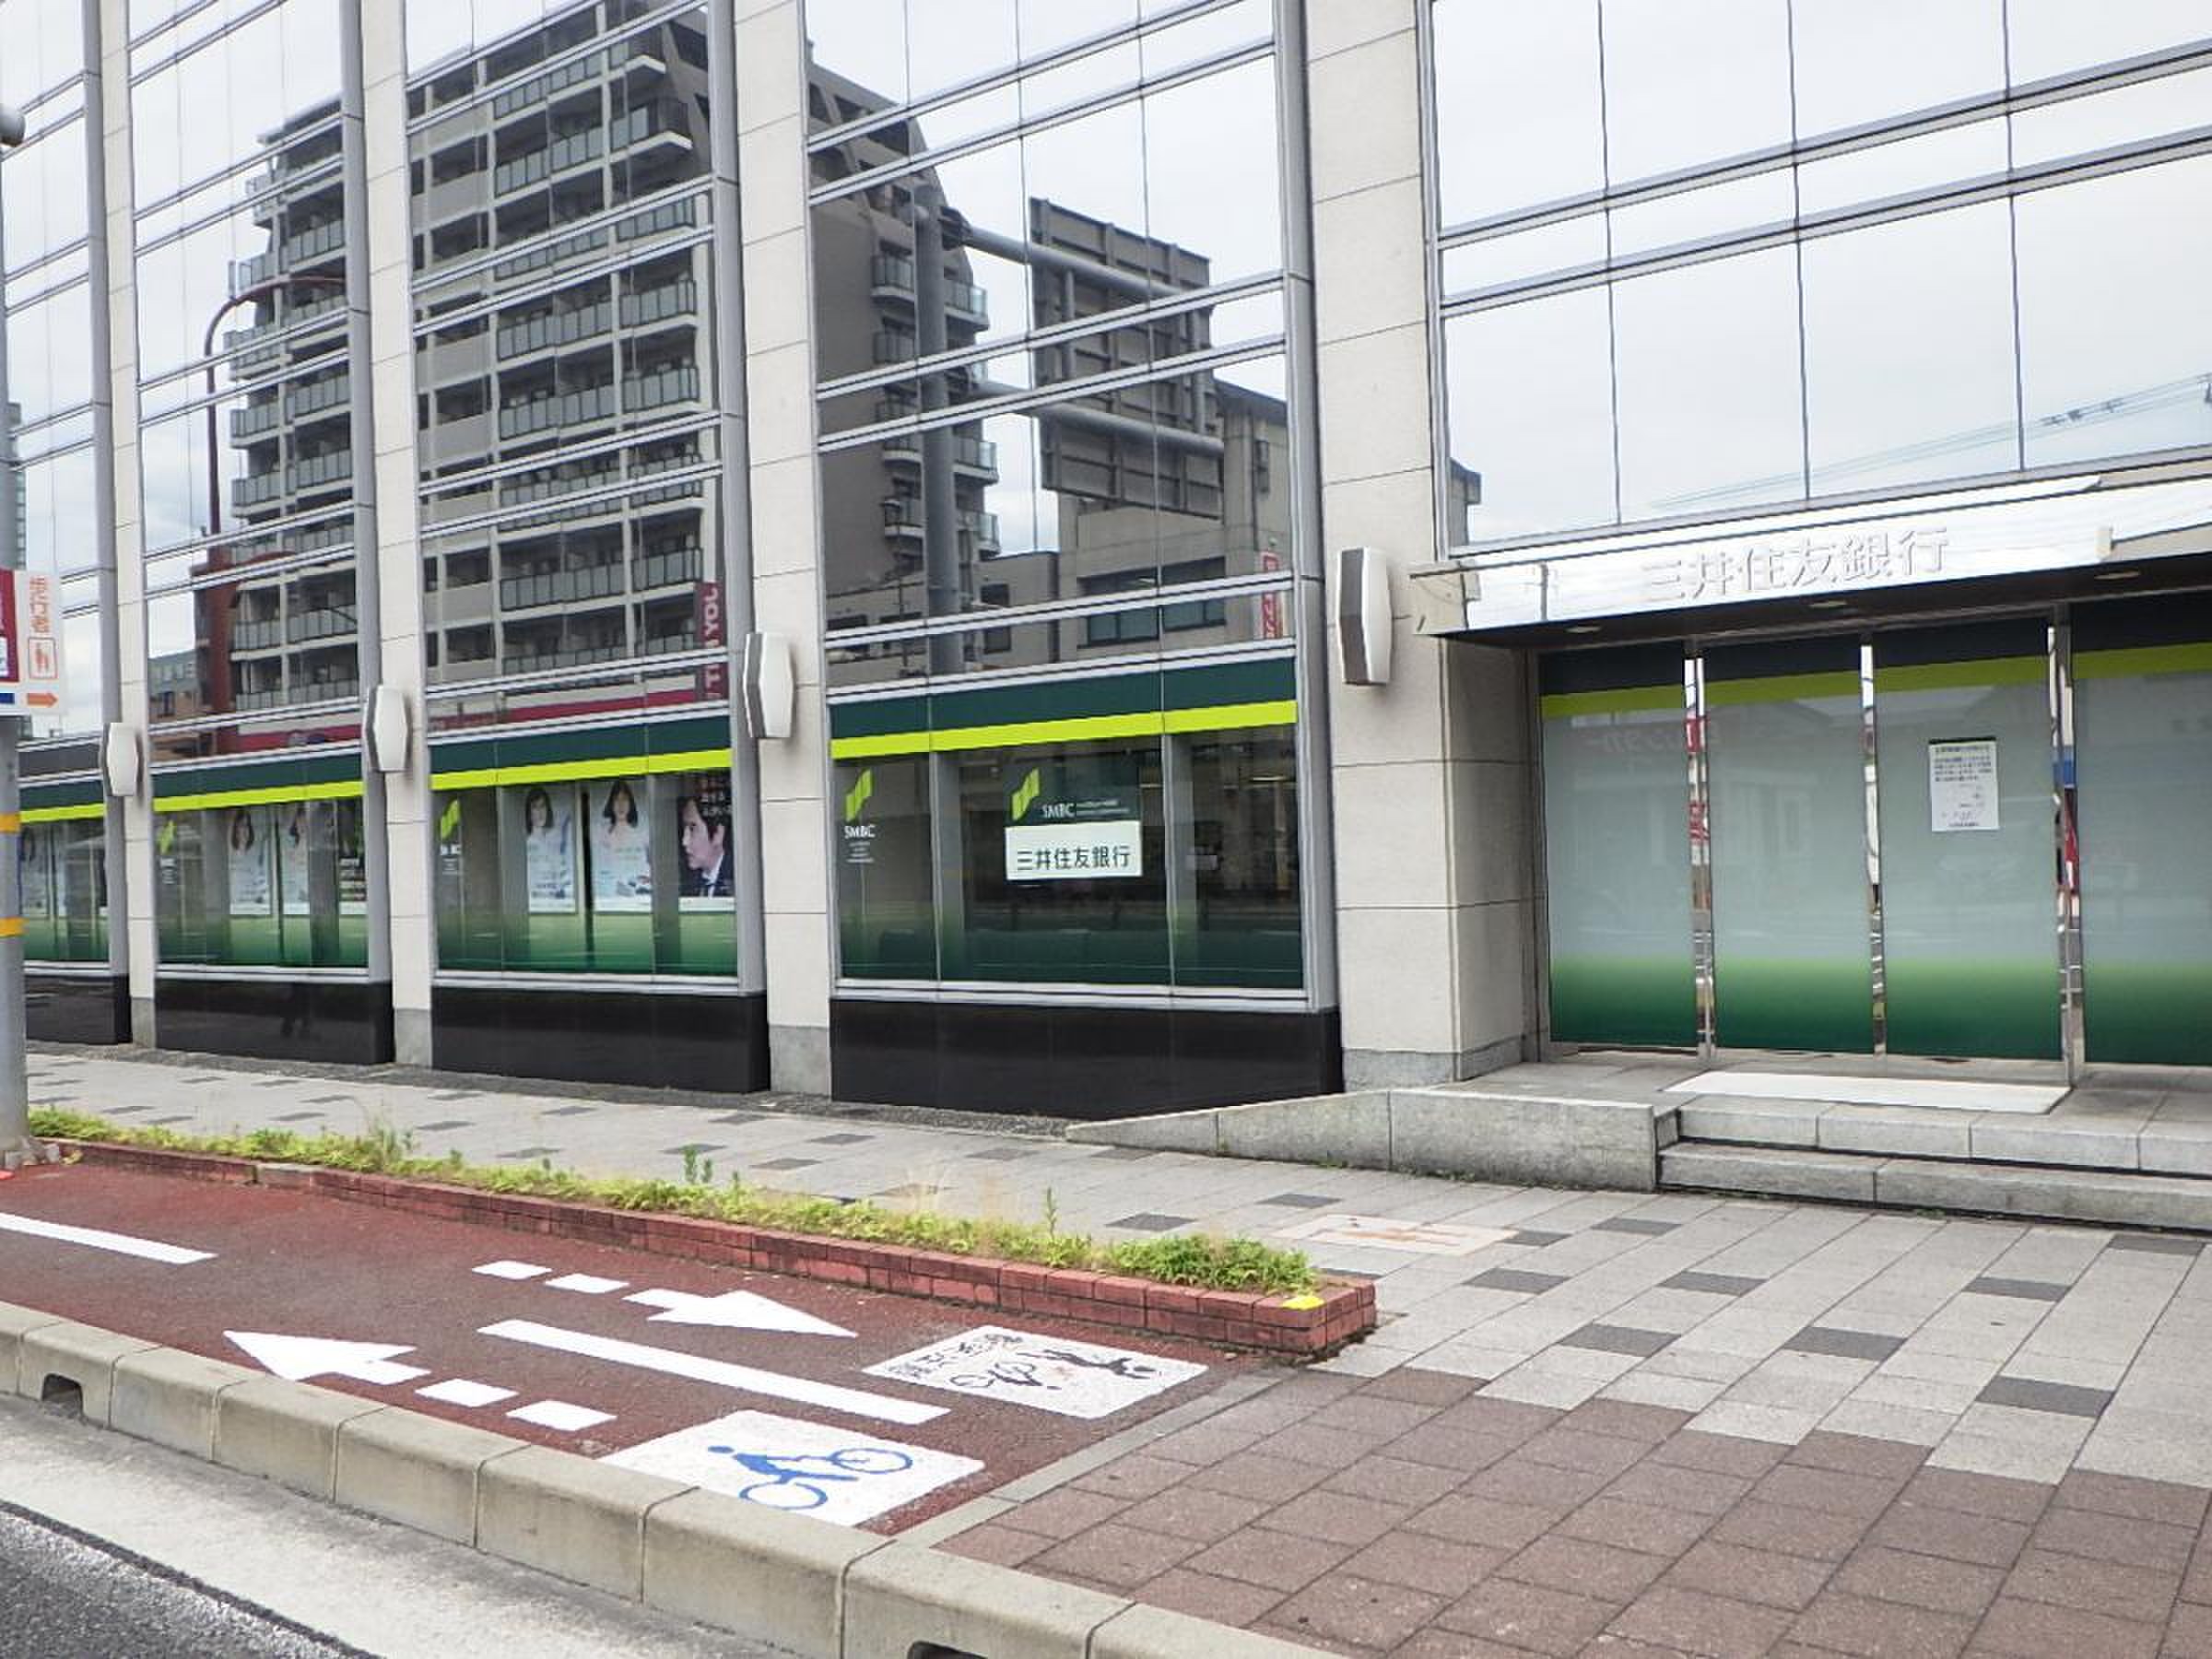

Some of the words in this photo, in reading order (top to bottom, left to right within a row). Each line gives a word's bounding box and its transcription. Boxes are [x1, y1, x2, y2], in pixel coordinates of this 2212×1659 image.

[1641, 526, 1949, 602] 三井住友銀行
[1041, 802, 1077, 818] SMBC
[844, 824, 877, 840] SMBC
[1017, 845, 1130, 871] 三井住友銀行
